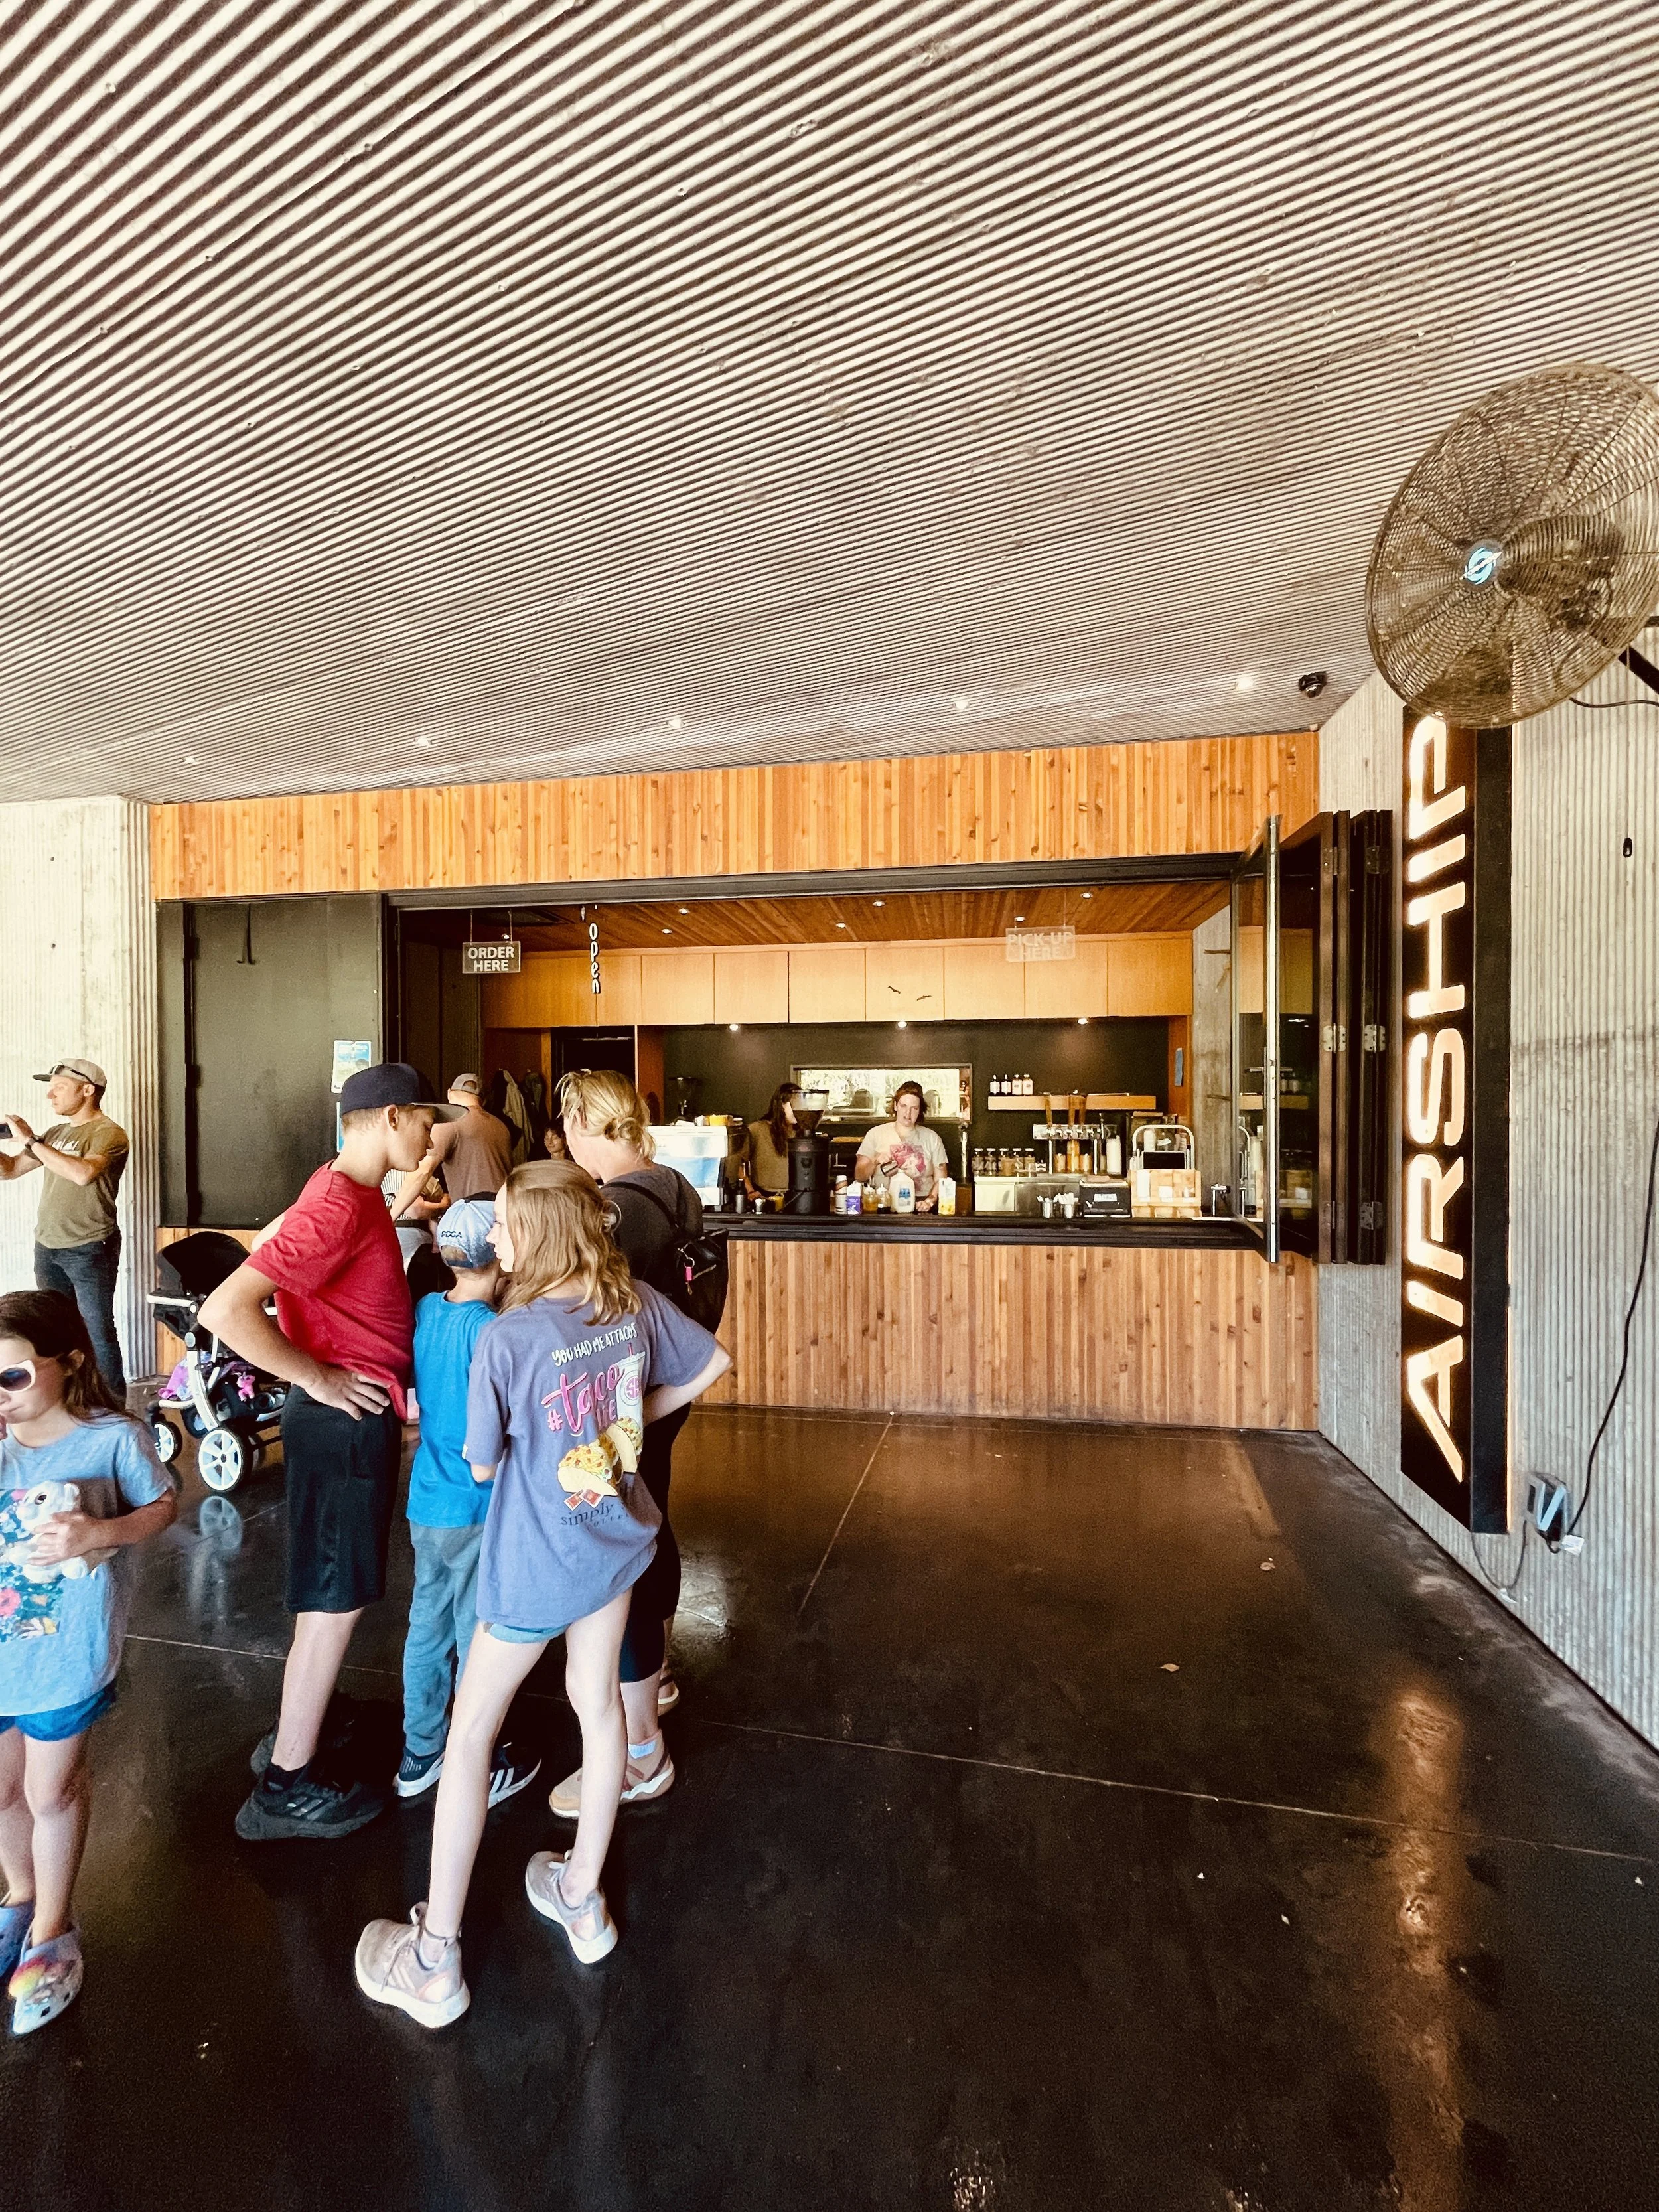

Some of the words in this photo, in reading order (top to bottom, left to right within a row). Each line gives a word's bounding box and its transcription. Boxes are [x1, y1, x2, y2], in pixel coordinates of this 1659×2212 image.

[467, 946, 514, 960] ORDER
[1019, 946, 1062, 961] HERE
[473, 960, 509, 972] HERE
[1408, 713, 1466, 1483] AIRSHIP
[551, 1347, 573, 1366] YOU
[574, 1339, 593, 1359] HAD
[592, 1335, 607, 1353] ME
[605, 1331, 615, 1347] AT
[613, 1322, 638, 1342] TACOS
[560, 1502, 614, 1526] simply
